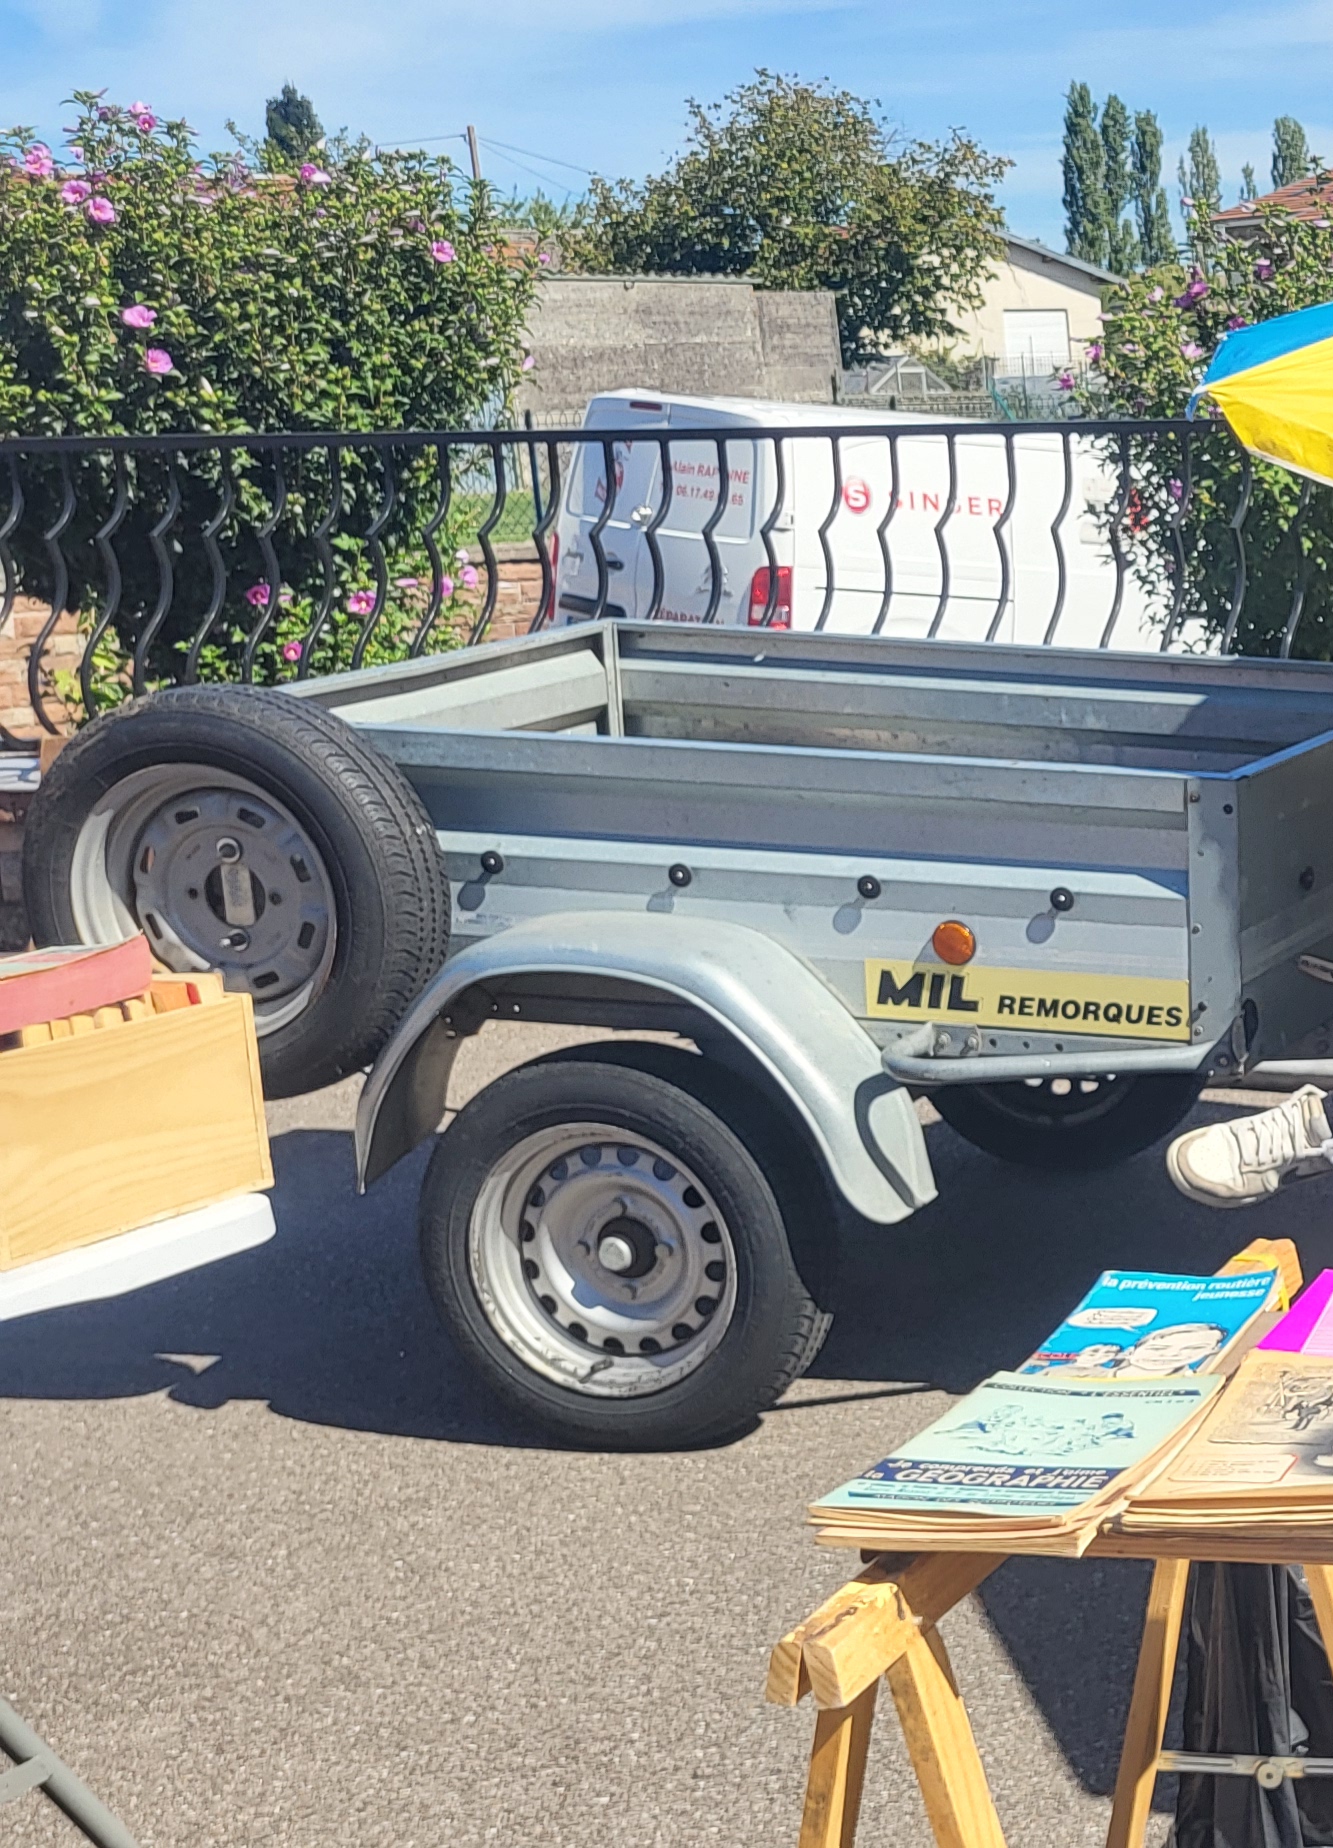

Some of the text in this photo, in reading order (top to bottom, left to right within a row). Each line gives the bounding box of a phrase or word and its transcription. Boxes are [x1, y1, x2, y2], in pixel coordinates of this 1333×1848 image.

[889, 490, 1004, 517] INER
[877, 969, 1183, 1028] MIL REMORQUES
[1102, 1275, 1272, 1292] la prévention routière
[1191, 1287, 1266, 1302] jeunesse
[863, 1469, 885, 1480] la
[888, 1458, 912, 1470] Je
[919, 1461, 1016, 1475] comprends
[1023, 1467, 1044, 1476] et
